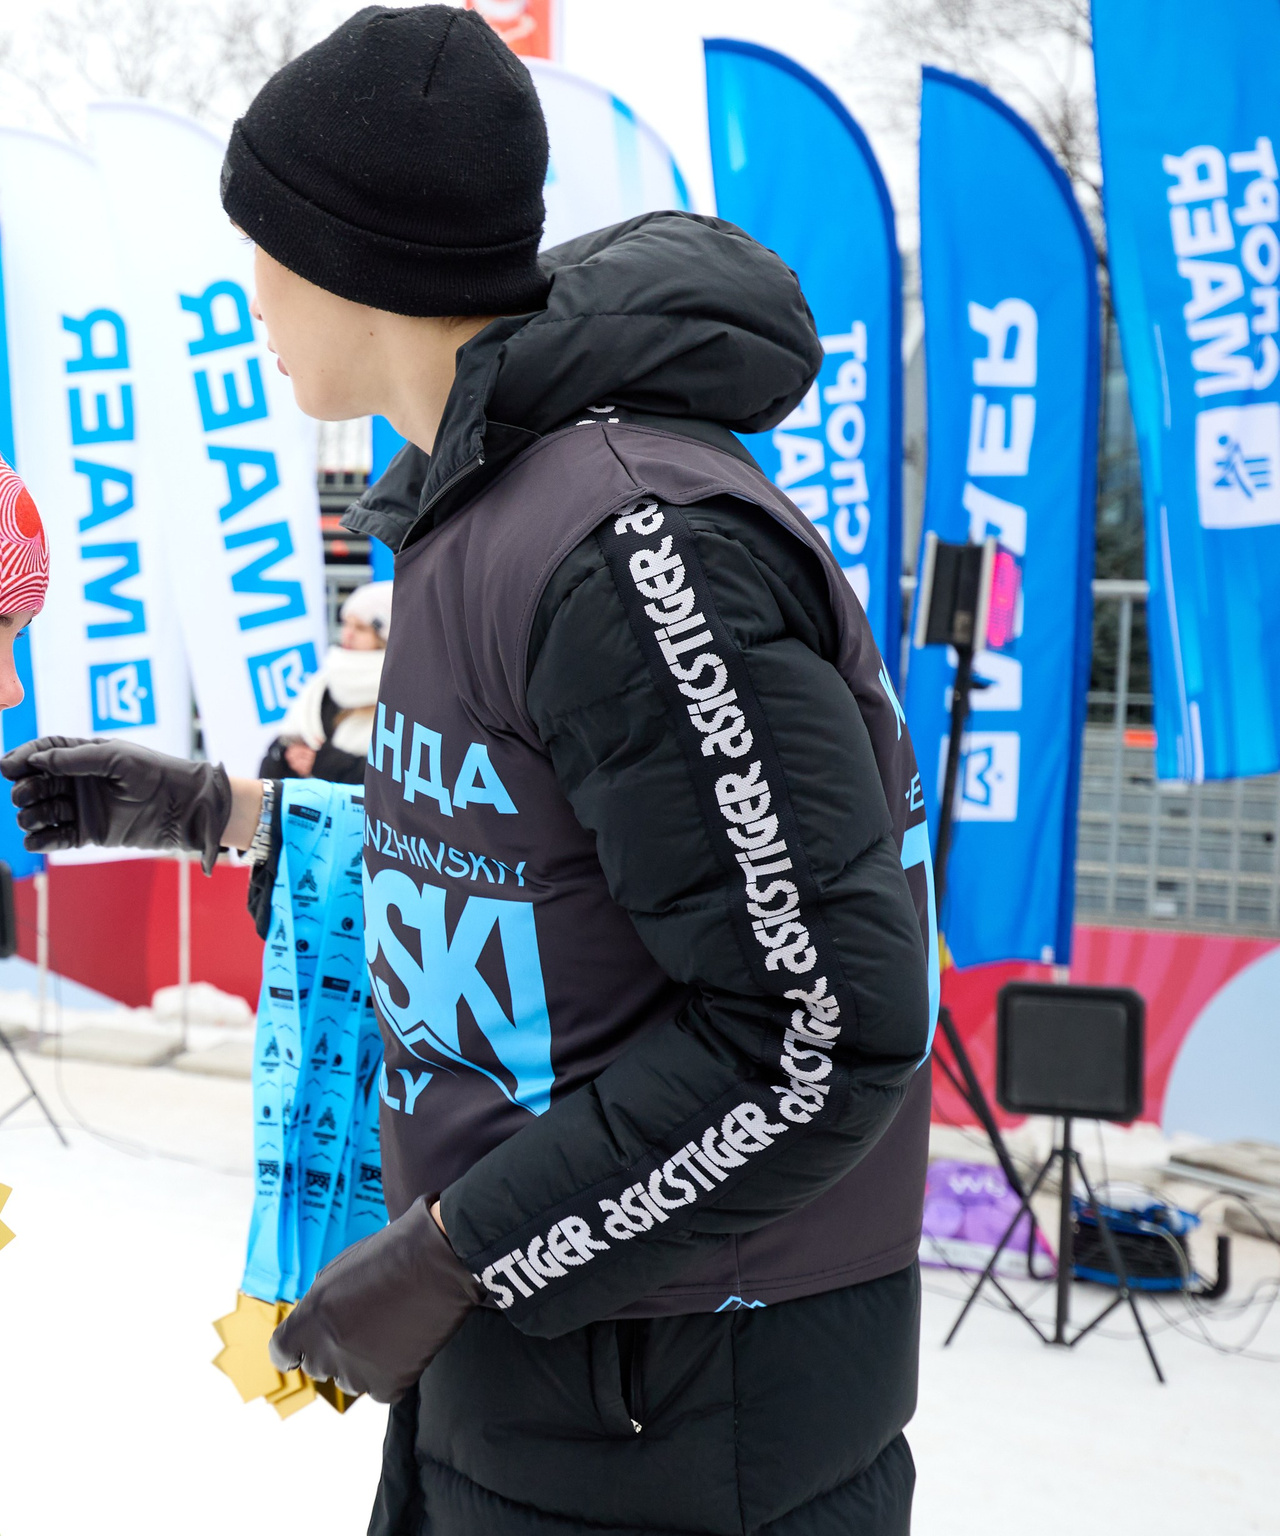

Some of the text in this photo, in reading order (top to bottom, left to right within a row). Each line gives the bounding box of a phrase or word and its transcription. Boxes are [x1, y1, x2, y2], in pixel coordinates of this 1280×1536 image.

[368, 701, 519, 817] НДА
[362, 813, 526, 887] NZHINSKIY
[379, 1061, 434, 1115] LY
